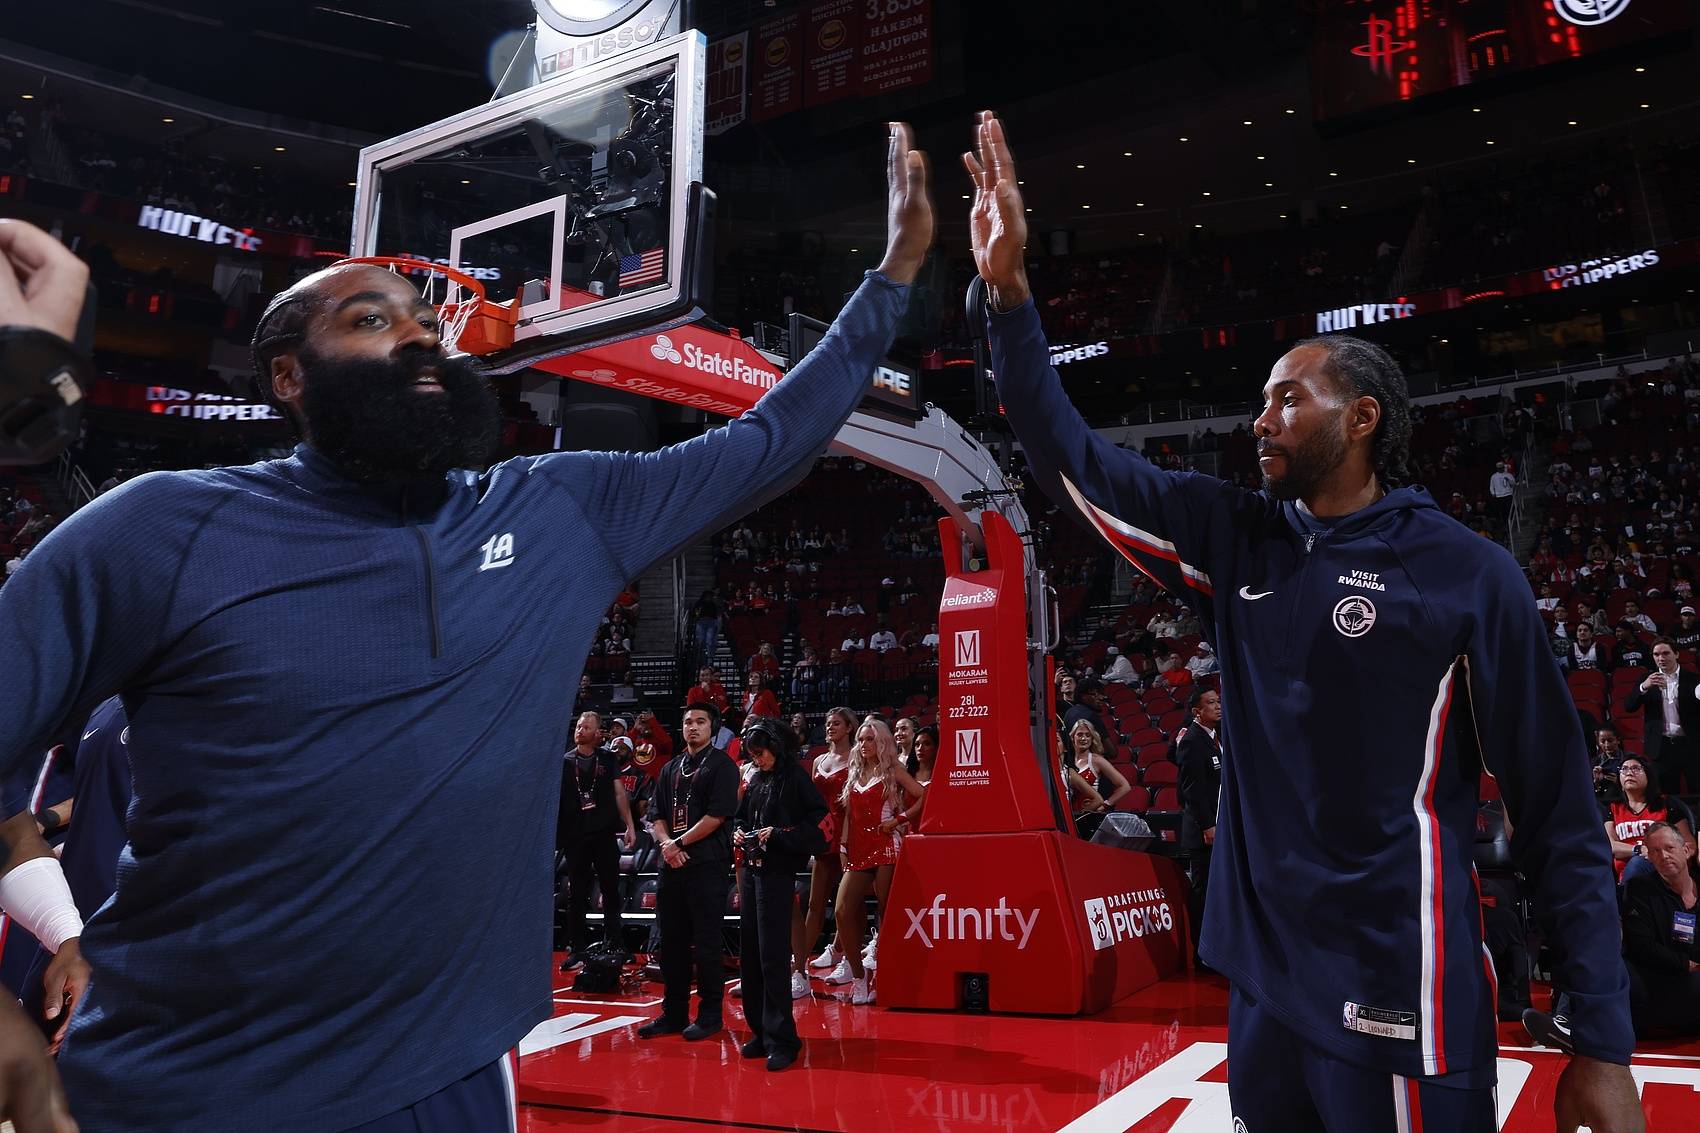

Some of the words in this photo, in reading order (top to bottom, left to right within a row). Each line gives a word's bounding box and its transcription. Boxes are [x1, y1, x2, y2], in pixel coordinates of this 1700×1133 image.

[1351, 569, 1380, 582] VISIT
[1337, 575, 1386, 592] RWANDA
[942, 592, 983, 607] reliant
[948, 669, 988, 678] MOKARAM
[960, 695, 975, 706] 281
[949, 706, 989, 718] 222-2222
[949, 770, 990, 779] MOKARAM
[1107, 888, 1165, 908] DRAFTKINGS
[904, 894, 1040, 950] xfinity
